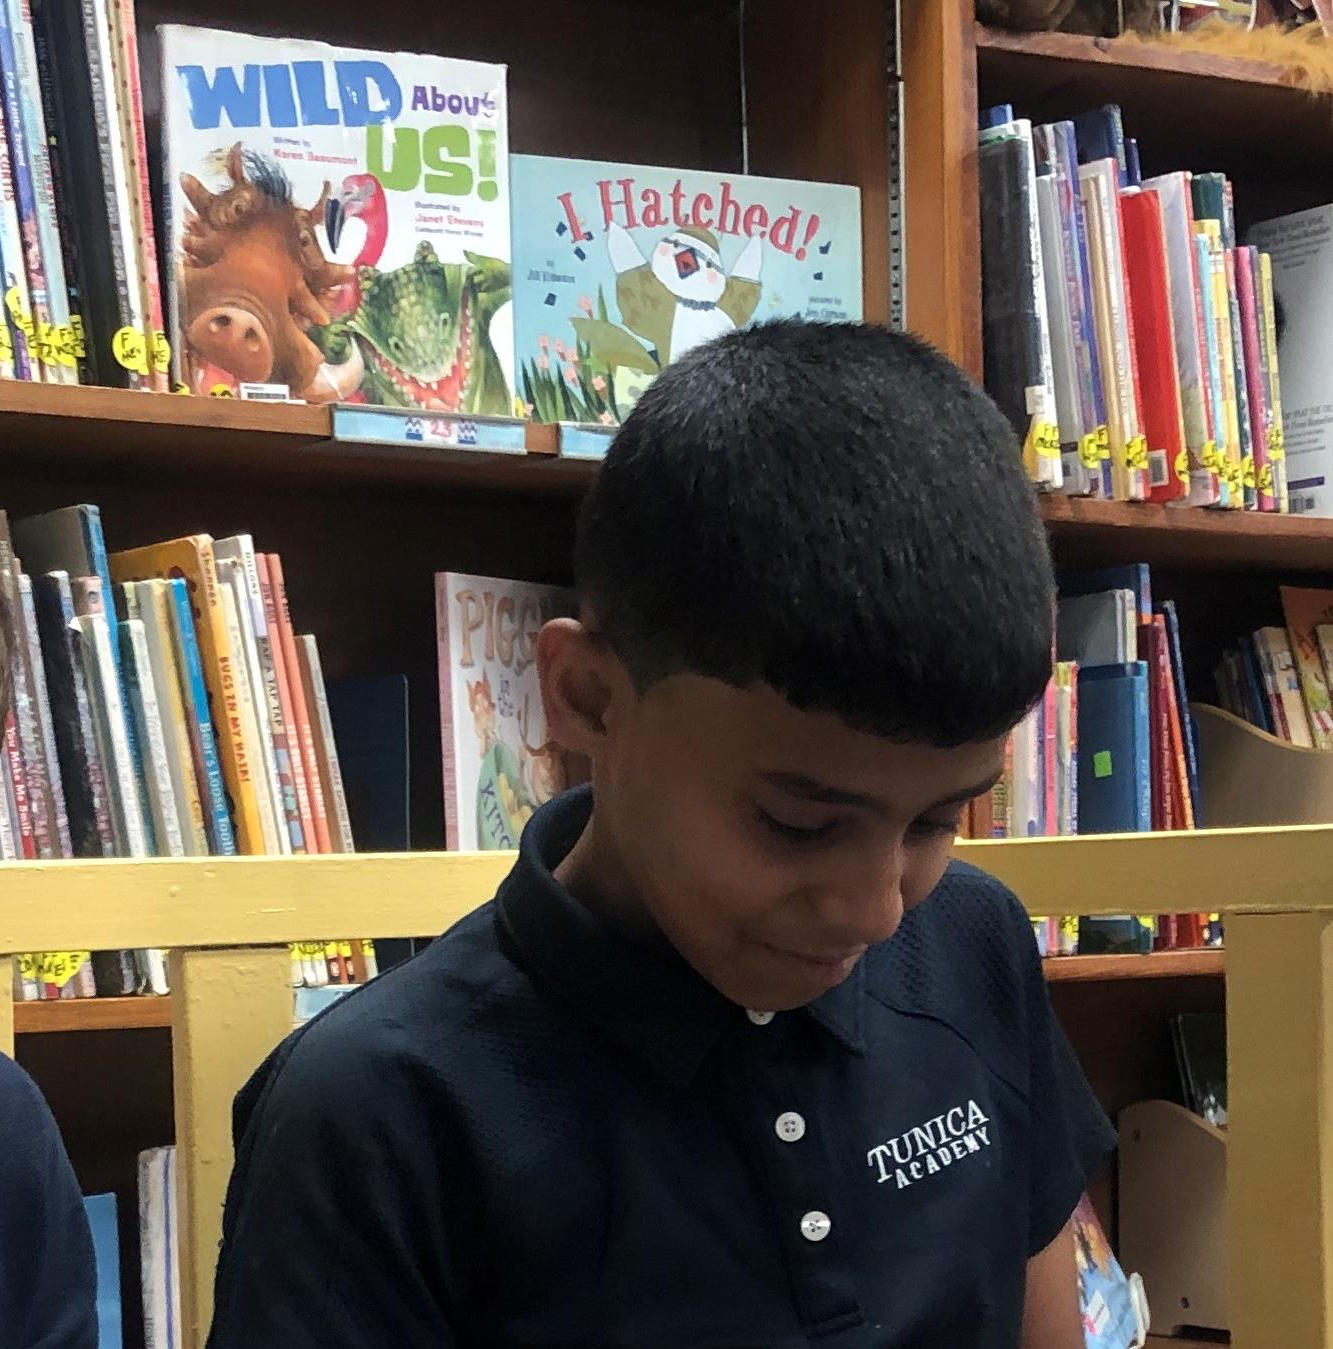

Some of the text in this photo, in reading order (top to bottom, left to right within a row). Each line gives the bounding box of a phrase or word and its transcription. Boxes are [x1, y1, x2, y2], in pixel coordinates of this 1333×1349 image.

[175, 60, 403, 130] WILD
[411, 85, 498, 118] About
[273, 148, 304, 160] Karen
[365, 123, 499, 202] US!
[415, 213, 444, 224] Janet
[556, 178, 820, 262] I Hatched!
[218, 656, 234, 693] BUGS
[266, 678, 279, 704] TAP
[224, 693, 238, 709] IN
[272, 706, 283, 727] TAP
[230, 719, 242, 738] MY
[4, 726, 30, 837] You Make Me Smile
[234, 741, 251, 783] HAIR!
[199, 722, 236, 856] Bear's Loose Tooth
[866, 1099, 990, 1184] TUNICA
[894, 1126, 991, 1190] ACADEMY
